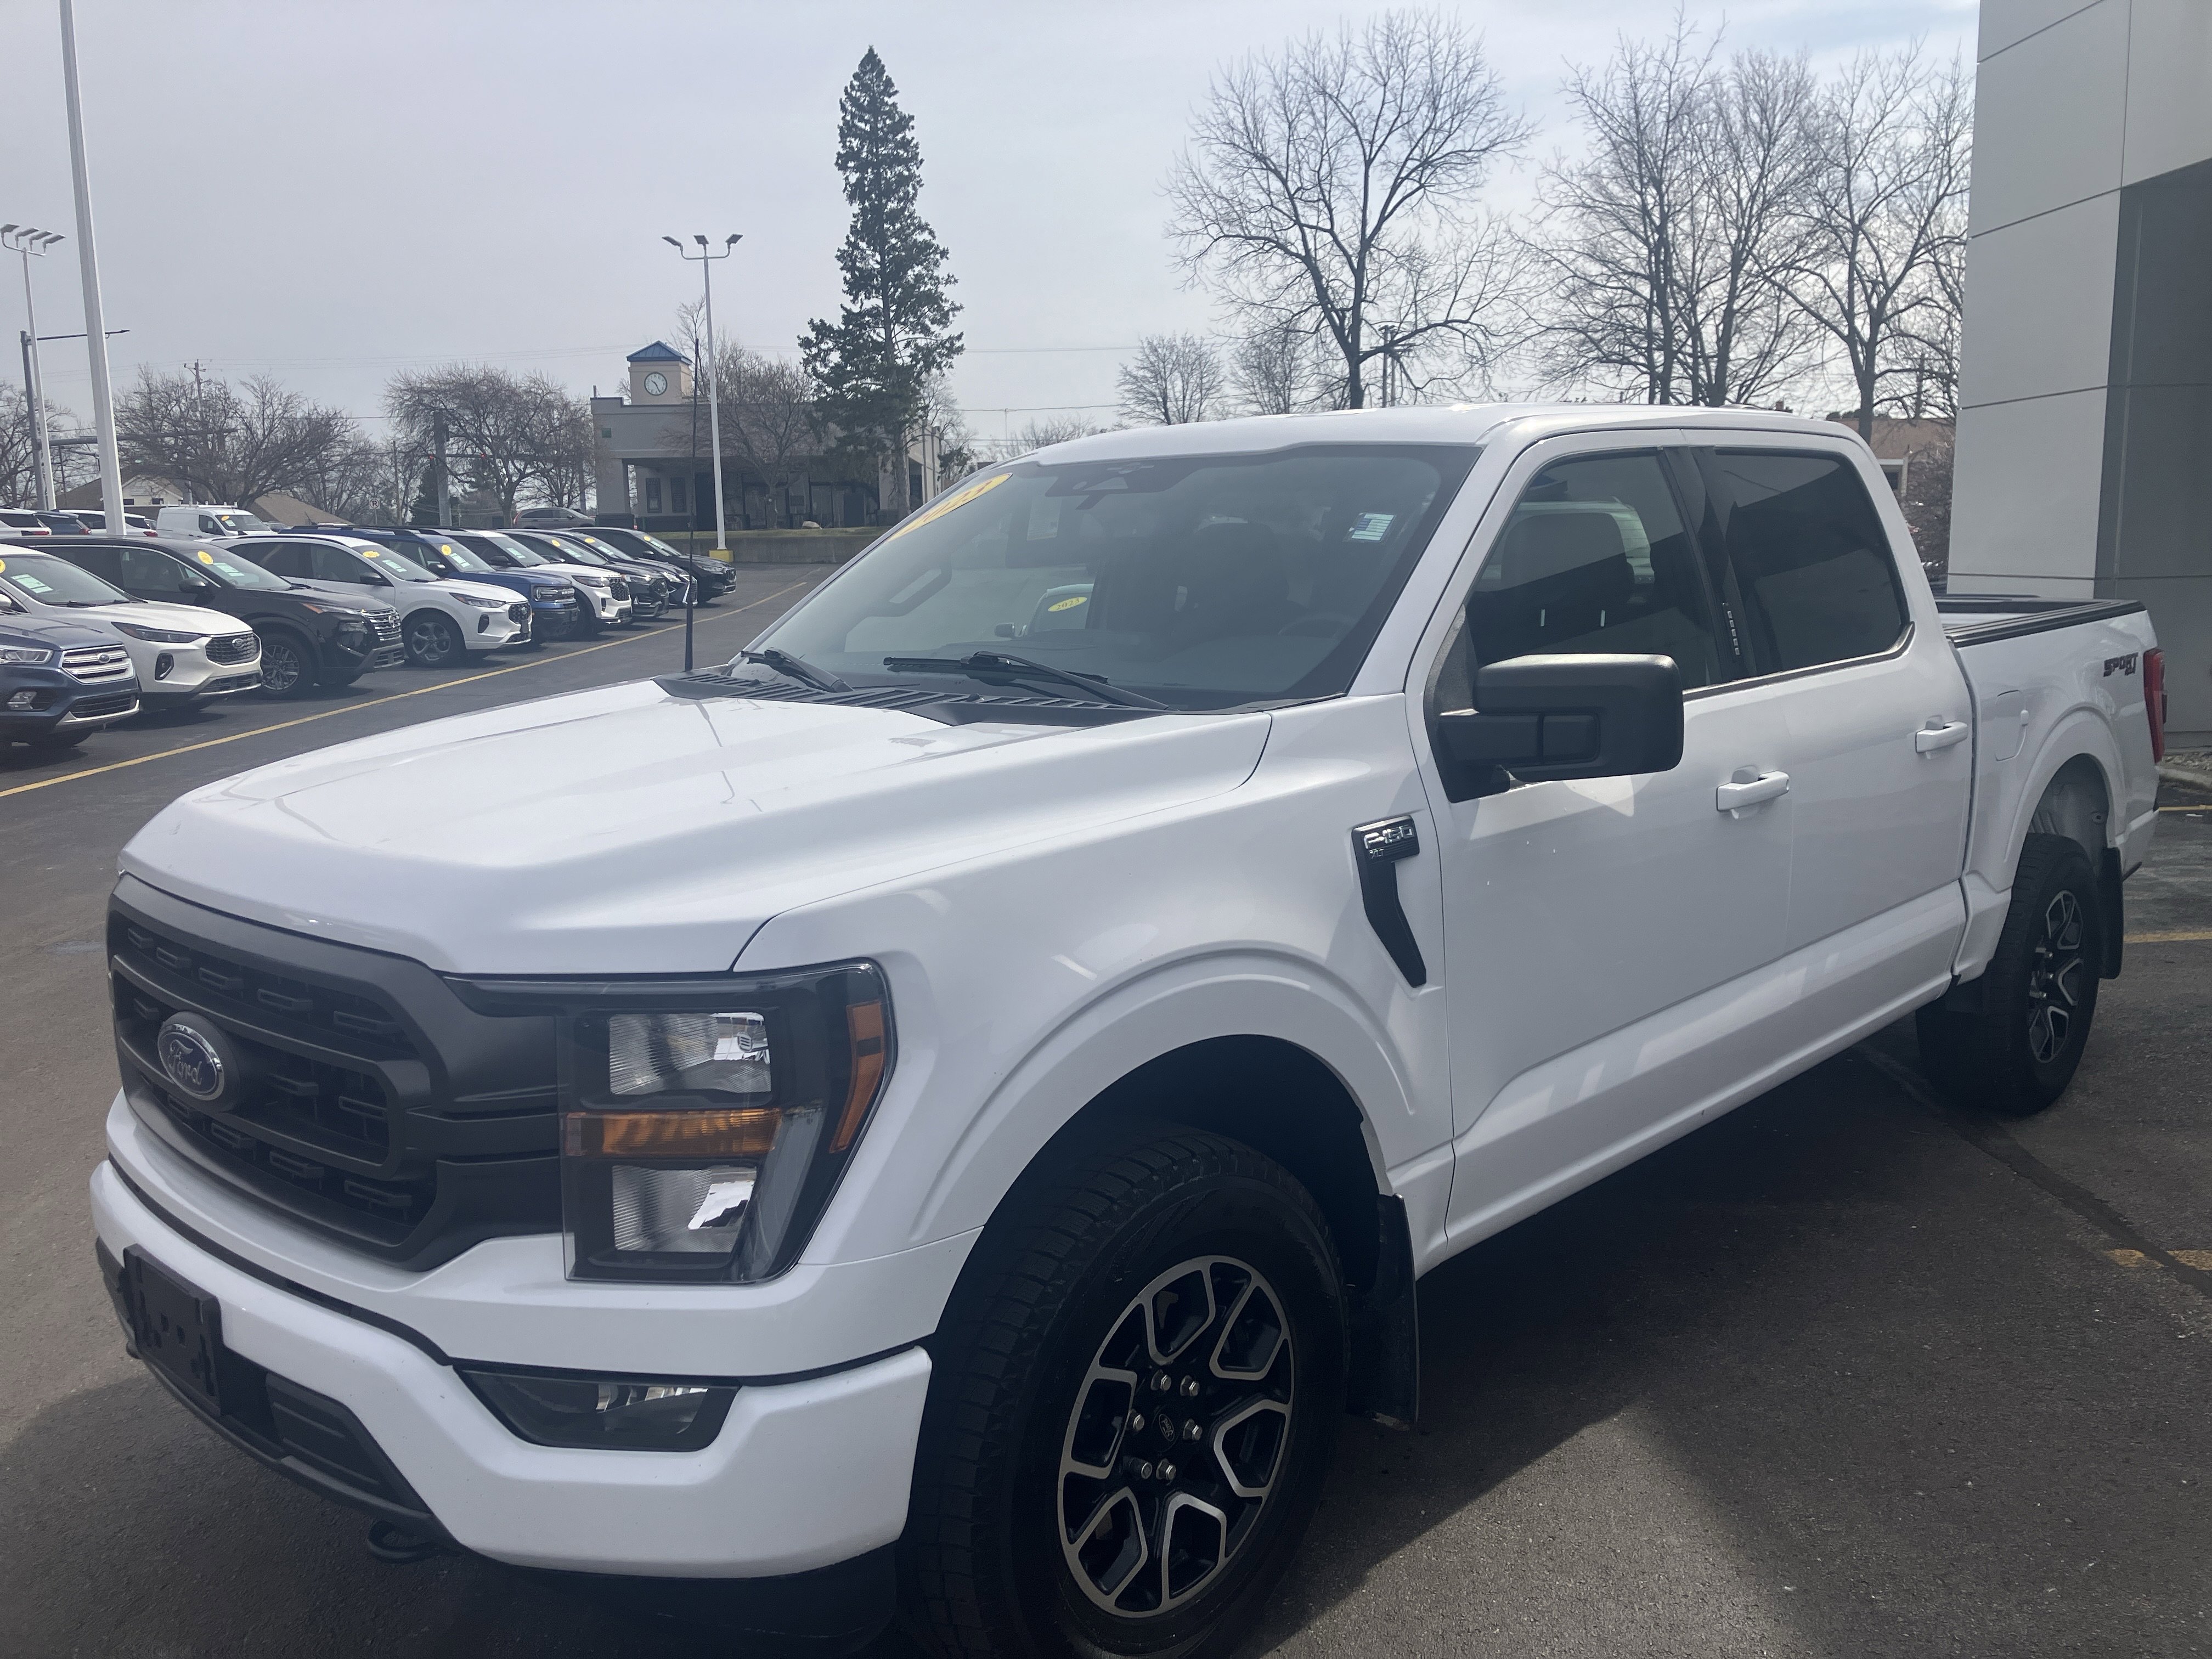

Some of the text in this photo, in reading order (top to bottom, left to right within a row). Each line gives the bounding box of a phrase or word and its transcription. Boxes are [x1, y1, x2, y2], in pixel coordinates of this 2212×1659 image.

[1056, 597, 1080, 611] 2023
[1363, 823, 1414, 849] F-150
[1368, 848, 1385, 859] XLT
[167, 1039, 202, 1086] Ford
[1161, 1417, 1173, 1437] Ford
